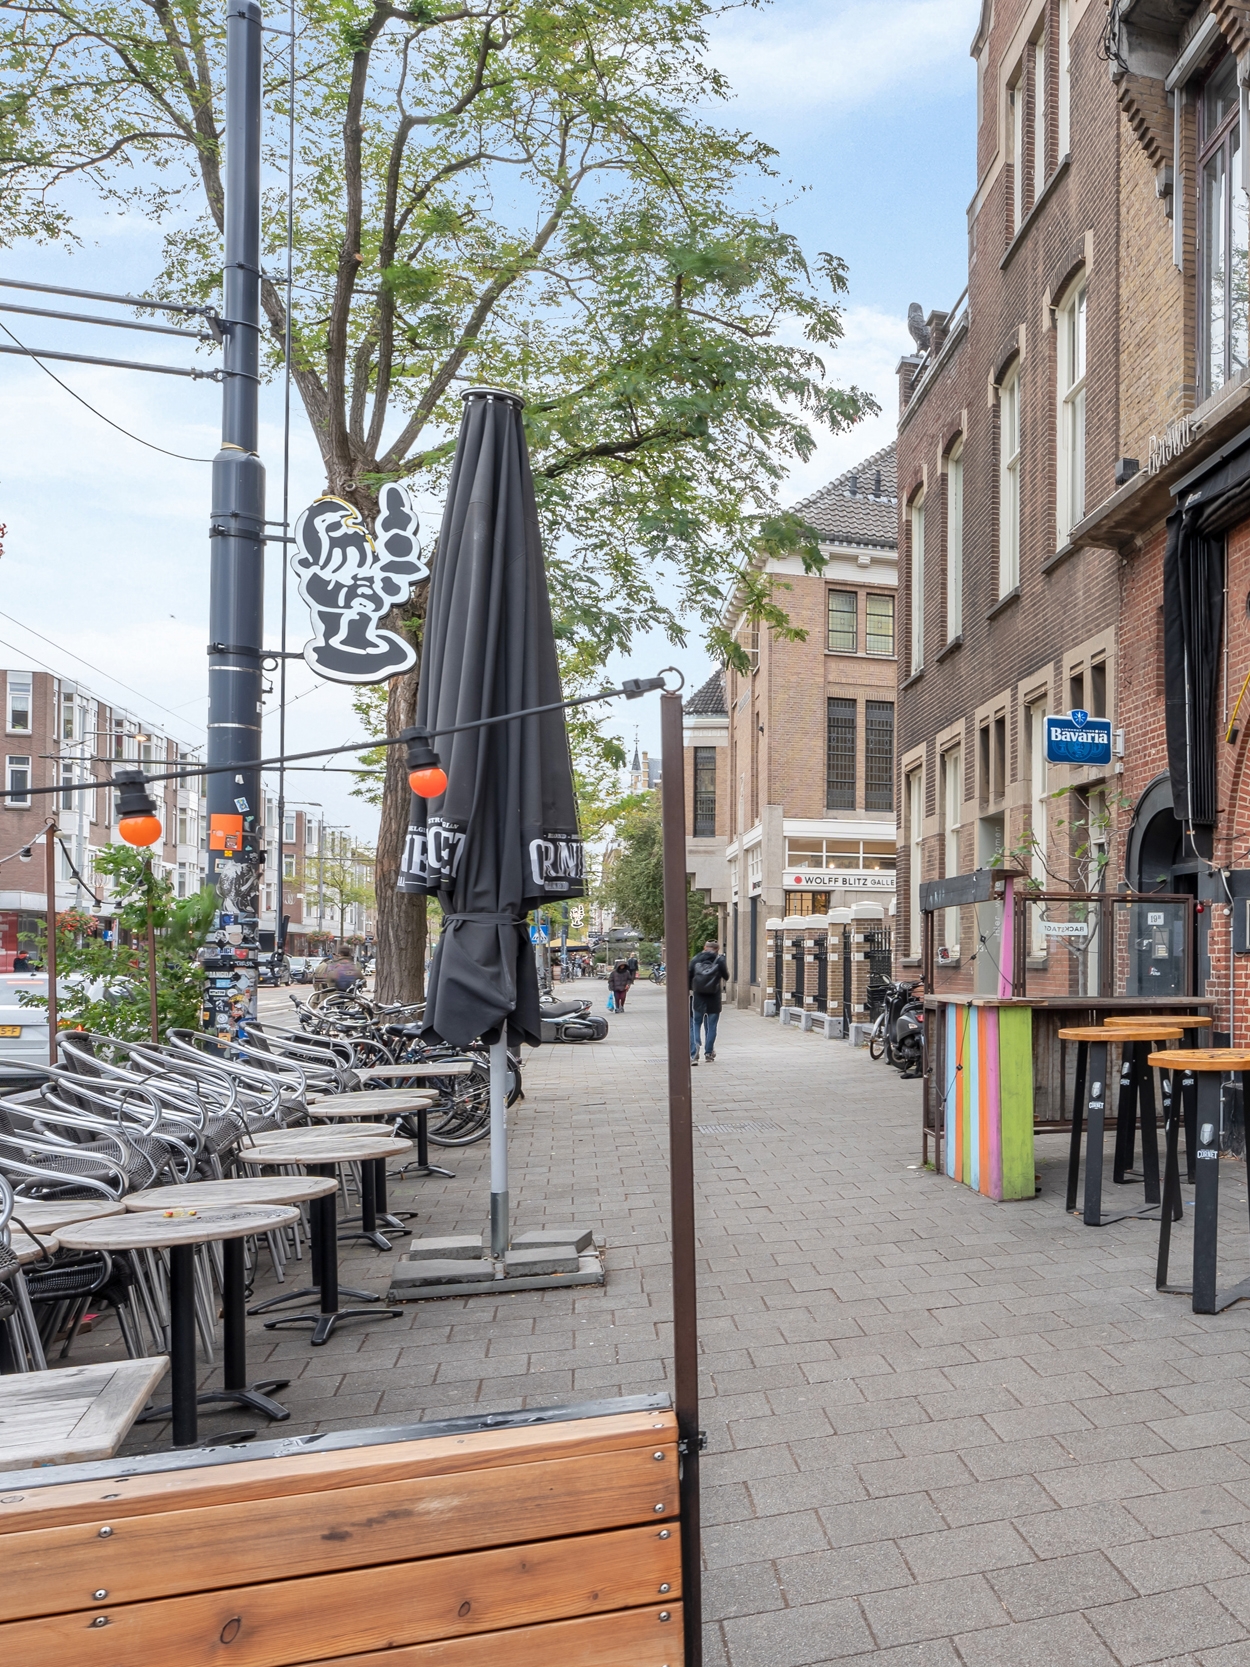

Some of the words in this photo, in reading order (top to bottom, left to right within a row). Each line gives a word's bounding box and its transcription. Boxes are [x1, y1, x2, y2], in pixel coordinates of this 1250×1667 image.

[1050, 727, 1108, 744] Bavaria
[804, 876, 839, 885] WOLFF
[842, 877, 868, 886] BLITZ
[871, 878, 895, 886] GALLE
[1197, 1150, 1218, 1159] CORNET
